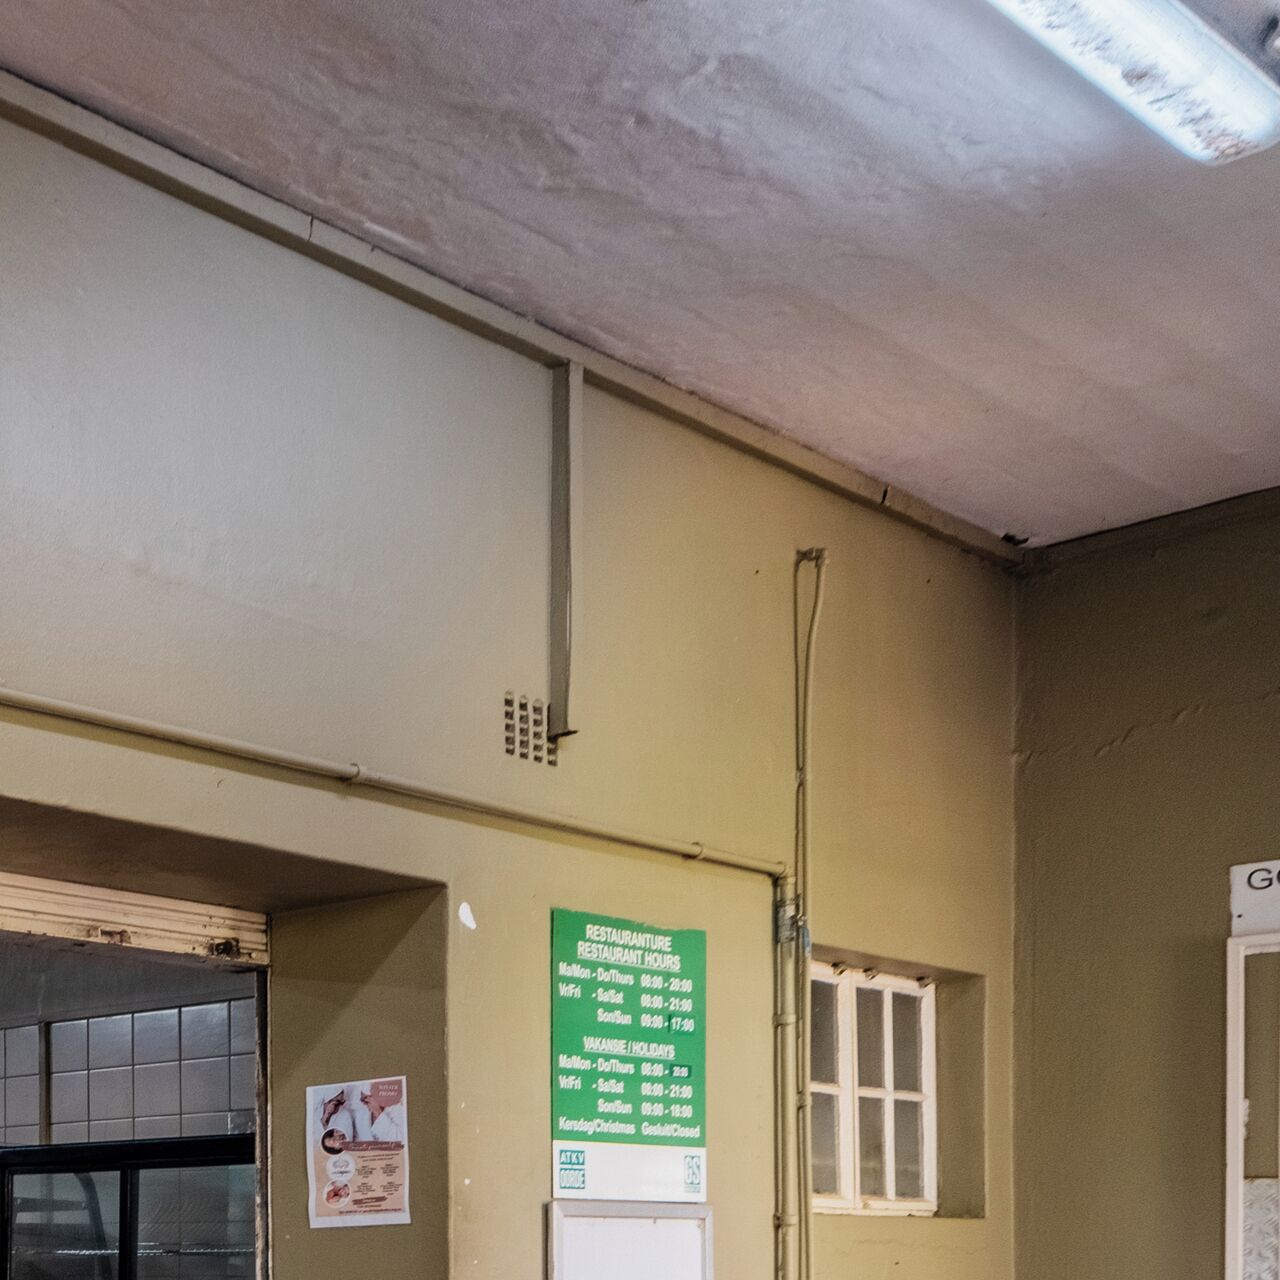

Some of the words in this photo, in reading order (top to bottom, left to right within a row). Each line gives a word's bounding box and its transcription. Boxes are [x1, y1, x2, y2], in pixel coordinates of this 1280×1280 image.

[1246, 867, 1280, 891] G
[586, 923, 672, 952] RESTAURANTURE
[577, 941, 643, 966] RESTAURANT
[645, 953, 681, 971] HOURS
[558, 961, 591, 979] Ma/Mon
[597, 967, 634, 986] Do/Thurs
[669, 997, 692, 1013] 21:00
[671, 1017, 695, 1032] 17:00
[583, 1035, 627, 1054] VAKANSIE
[632, 1041, 676, 1059] HOLIDAYS
[558, 1054, 591, 1070] Ma/Mon
[597, 1058, 635, 1074] Do/Thurs
[669, 1084, 692, 1099] 21:00
[560, 1151, 585, 1164] ATKV
